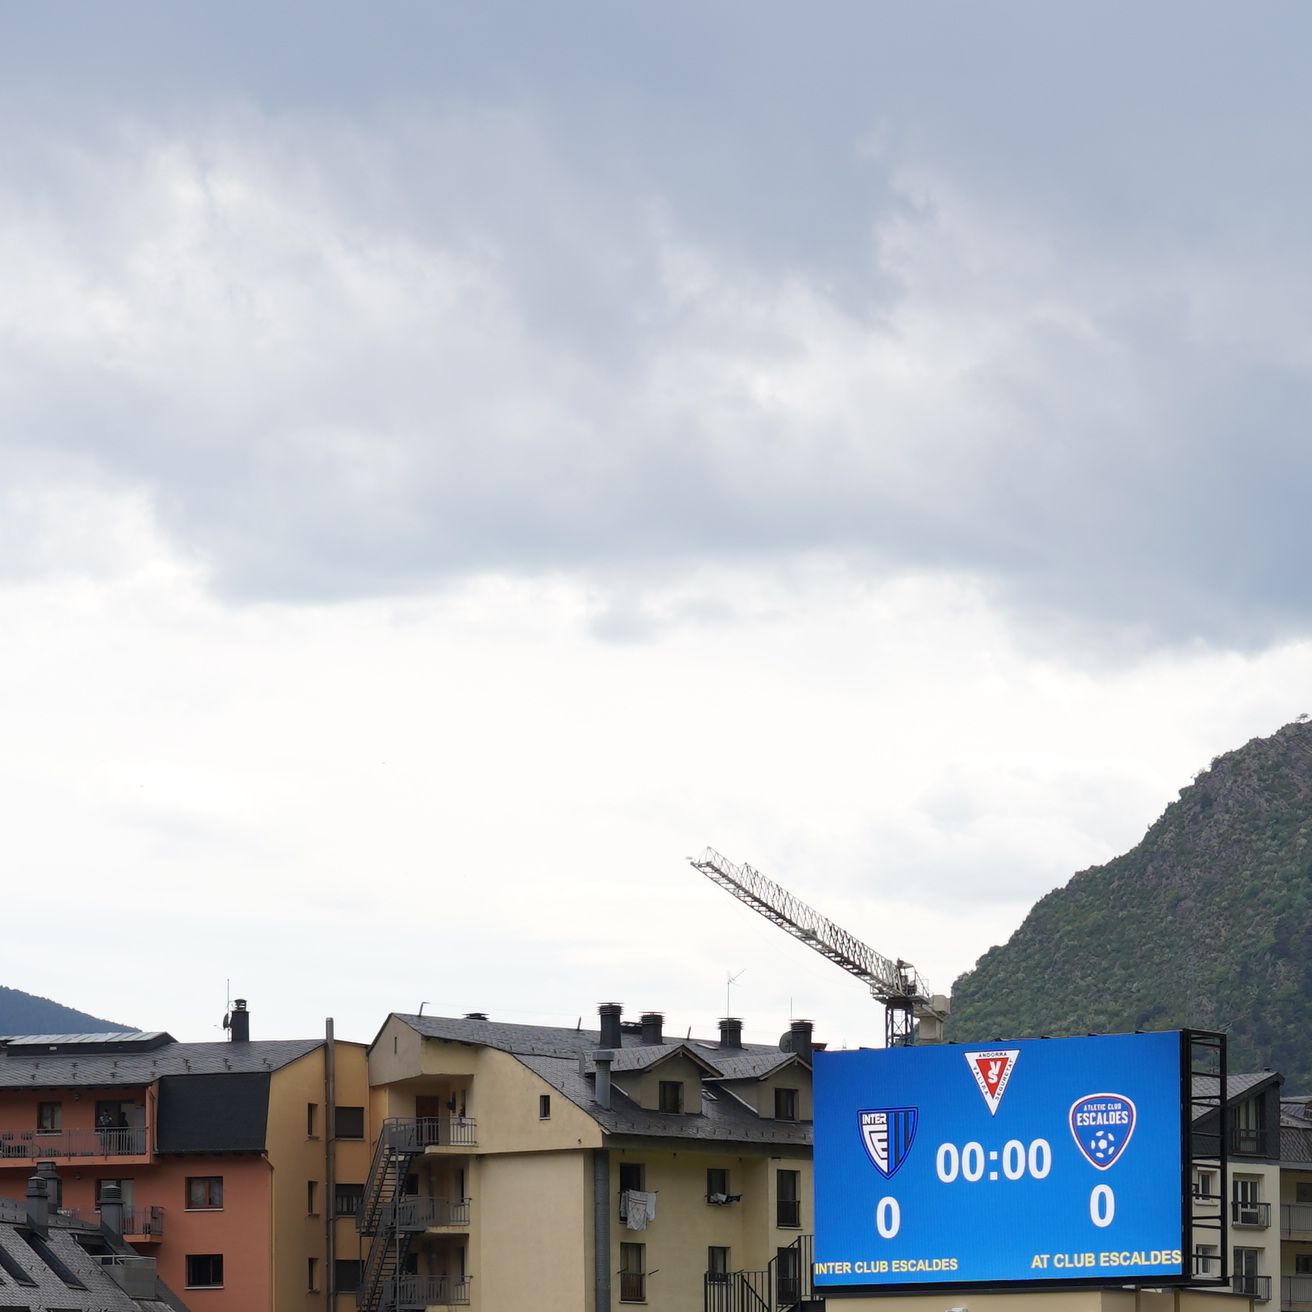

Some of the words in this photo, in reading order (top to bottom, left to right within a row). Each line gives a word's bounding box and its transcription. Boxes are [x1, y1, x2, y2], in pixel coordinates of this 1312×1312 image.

[973, 1066, 989, 1096] VALIRA
[862, 1113, 887, 1124] INTER
[1077, 1111, 1129, 1126] ESCALDES
[936, 1138, 1052, 1183] 00:00
[876, 1196, 901, 1239] 0
[1090, 1184, 1115, 1228] 0
[815, 1261, 852, 1275] INTER
[854, 1260, 889, 1273] CLUB
[892, 1258, 959, 1272] ESCALDES
[1031, 1254, 1050, 1269] AT
[1053, 1253, 1096, 1268] CLUB
[1099, 1250, 1182, 1267] ESCALDES
